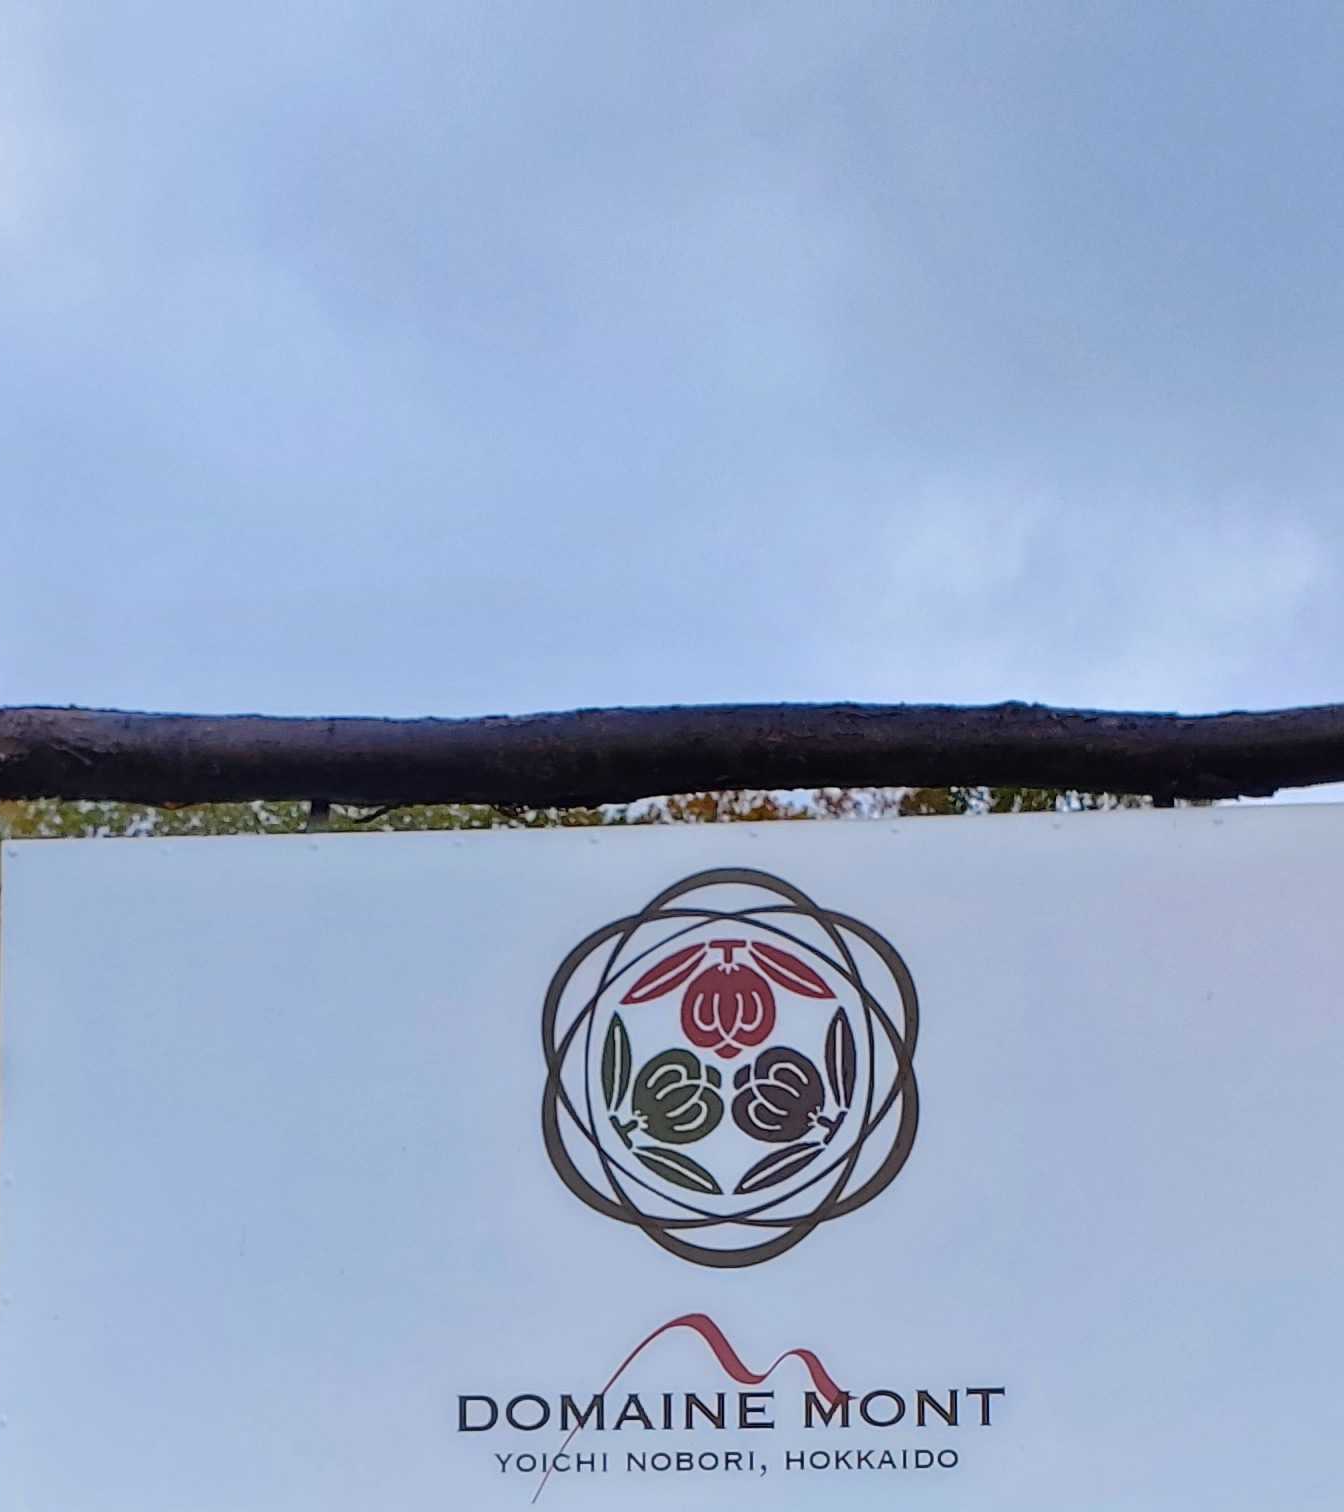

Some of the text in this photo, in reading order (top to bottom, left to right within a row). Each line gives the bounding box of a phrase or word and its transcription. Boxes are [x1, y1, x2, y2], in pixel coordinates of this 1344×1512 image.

[457, 1387, 1006, 1432] DOMAINE MONT
[495, 1448, 960, 1477] YOICHI NOBORI, HOKKAIDO
